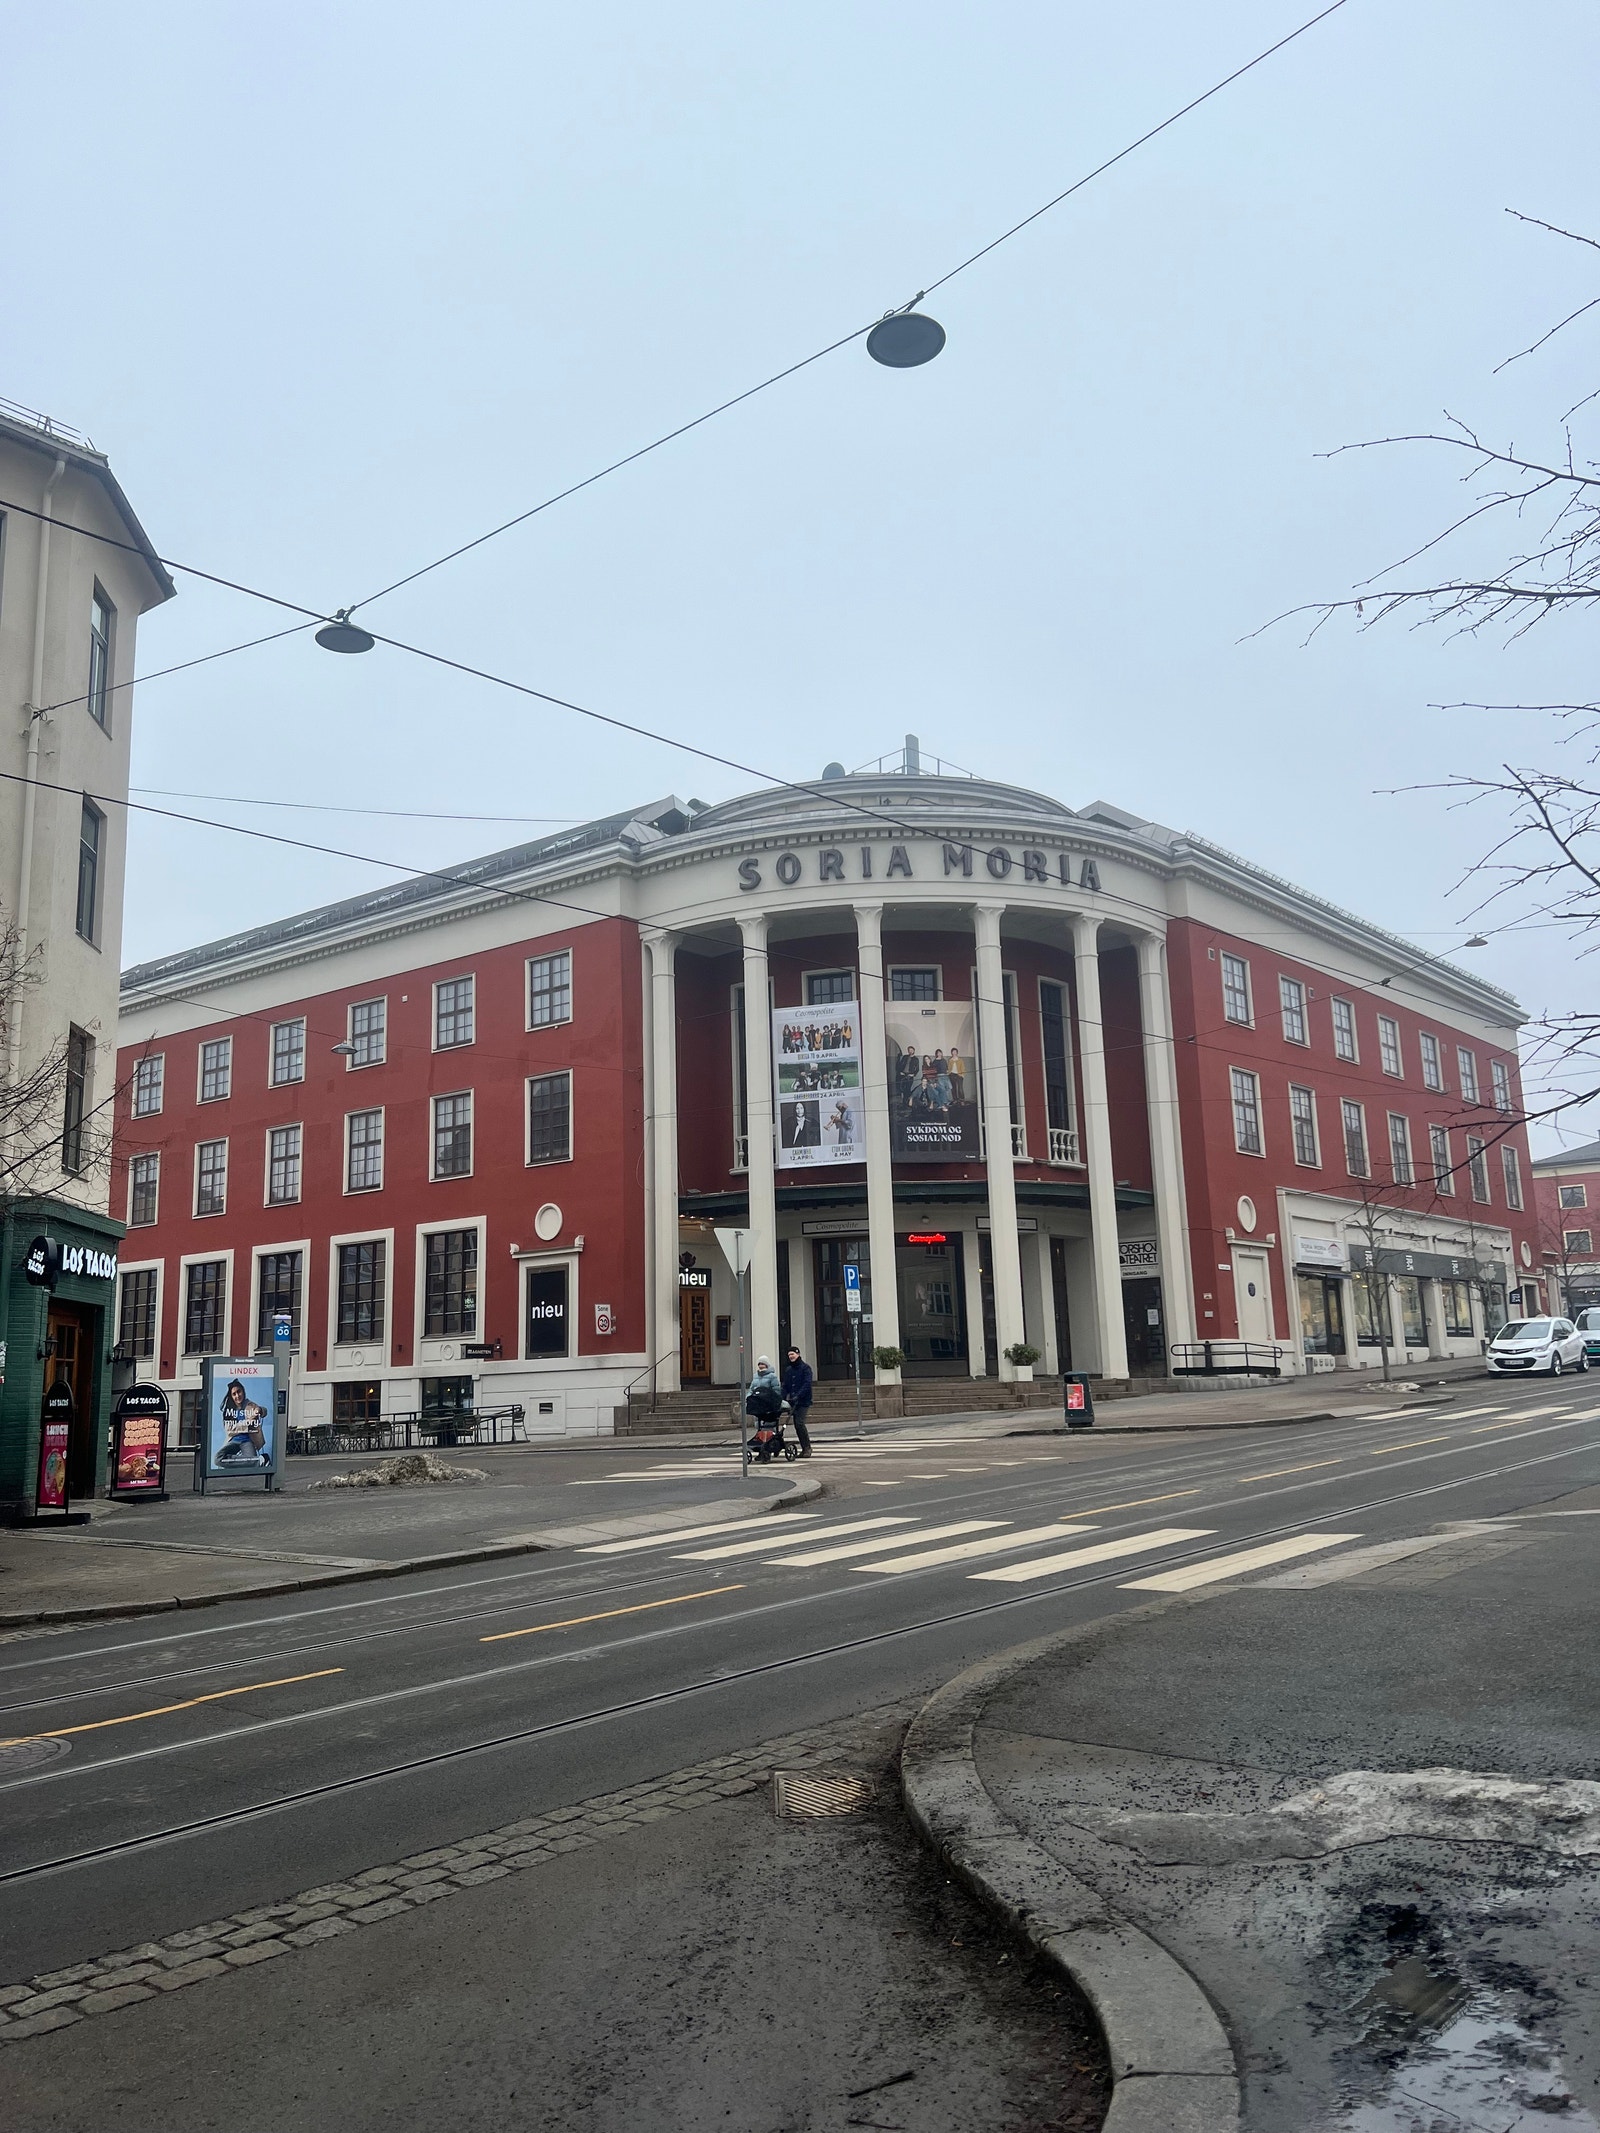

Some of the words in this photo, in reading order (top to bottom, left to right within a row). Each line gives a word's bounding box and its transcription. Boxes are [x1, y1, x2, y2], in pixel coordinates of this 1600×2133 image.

[738, 845, 913, 891] SORIA
[942, 843, 1102, 891] MORIA
[795, 1007, 835, 1018] Cosmopolite
[906, 1126, 947, 1134] SYKDOM
[948, 1126, 962, 1134] OG
[907, 1134, 940, 1142] SOSIAL
[815, 1222, 859, 1232] Cosmopolite
[908, 1233, 947, 1244] Cosmopolite
[1118, 1242, 1158, 1255] ORSHOV
[33, 1248, 45, 1262] LOS
[1124, 1253, 1158, 1265] TEATRET
[27, 1258, 45, 1276] TACOS
[62, 1243, 84, 1275] LOS
[85, 1248, 117, 1280] TACOS
[678, 1268, 707, 1286] nieu
[847, 1268, 856, 1287] P
[532, 1301, 564, 1319] nieu
[229, 1367, 259, 1375] LINDEX
[49, 1399, 57, 1407] LOS
[57, 1398, 69, 1407] TACOS
[126, 1397, 139, 1405] LOS
[140, 1397, 160, 1405] TACOS
[225, 1408, 239, 1418] My
[224, 1420, 238, 1430] my
